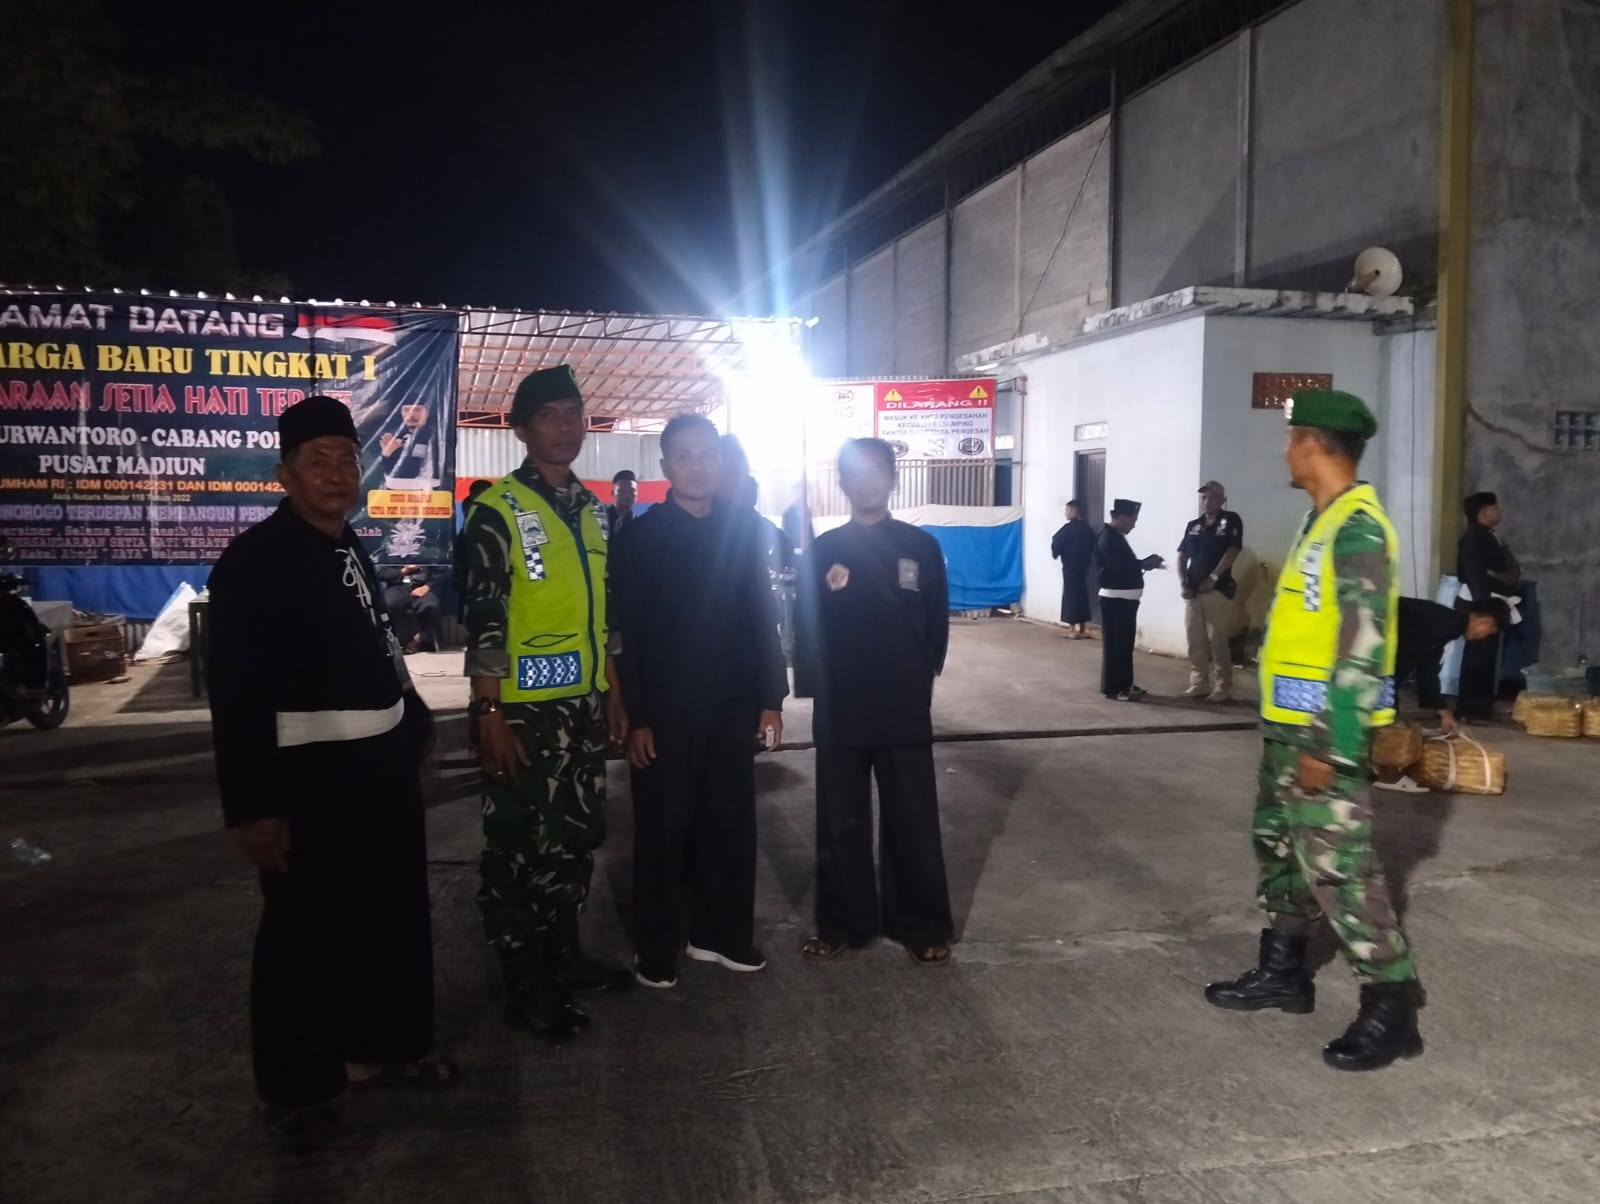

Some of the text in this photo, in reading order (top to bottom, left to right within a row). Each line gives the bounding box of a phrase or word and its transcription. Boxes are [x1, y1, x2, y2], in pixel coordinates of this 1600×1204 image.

[128, 305, 285, 339] DATANG
[96, 344, 195, 374] BARU
[205, 349, 352, 380] TINGKAT
[363, 355, 377, 381] I
[99, 383, 176, 414] SETIA
[184, 385, 249, 416] HATI
[886, 399, 972, 410] DILARANG
[151, 428, 242, 449] CABANG
[38, 454, 207, 476] PUSAT MADIUN
[76, 480, 101, 489] IDM
[177, 481, 205, 491] DAN
[208, 481, 232, 492] IDM
[66, 505, 143, 522] TERDEPAN
[146, 505, 236, 523] MEMBANGUN
